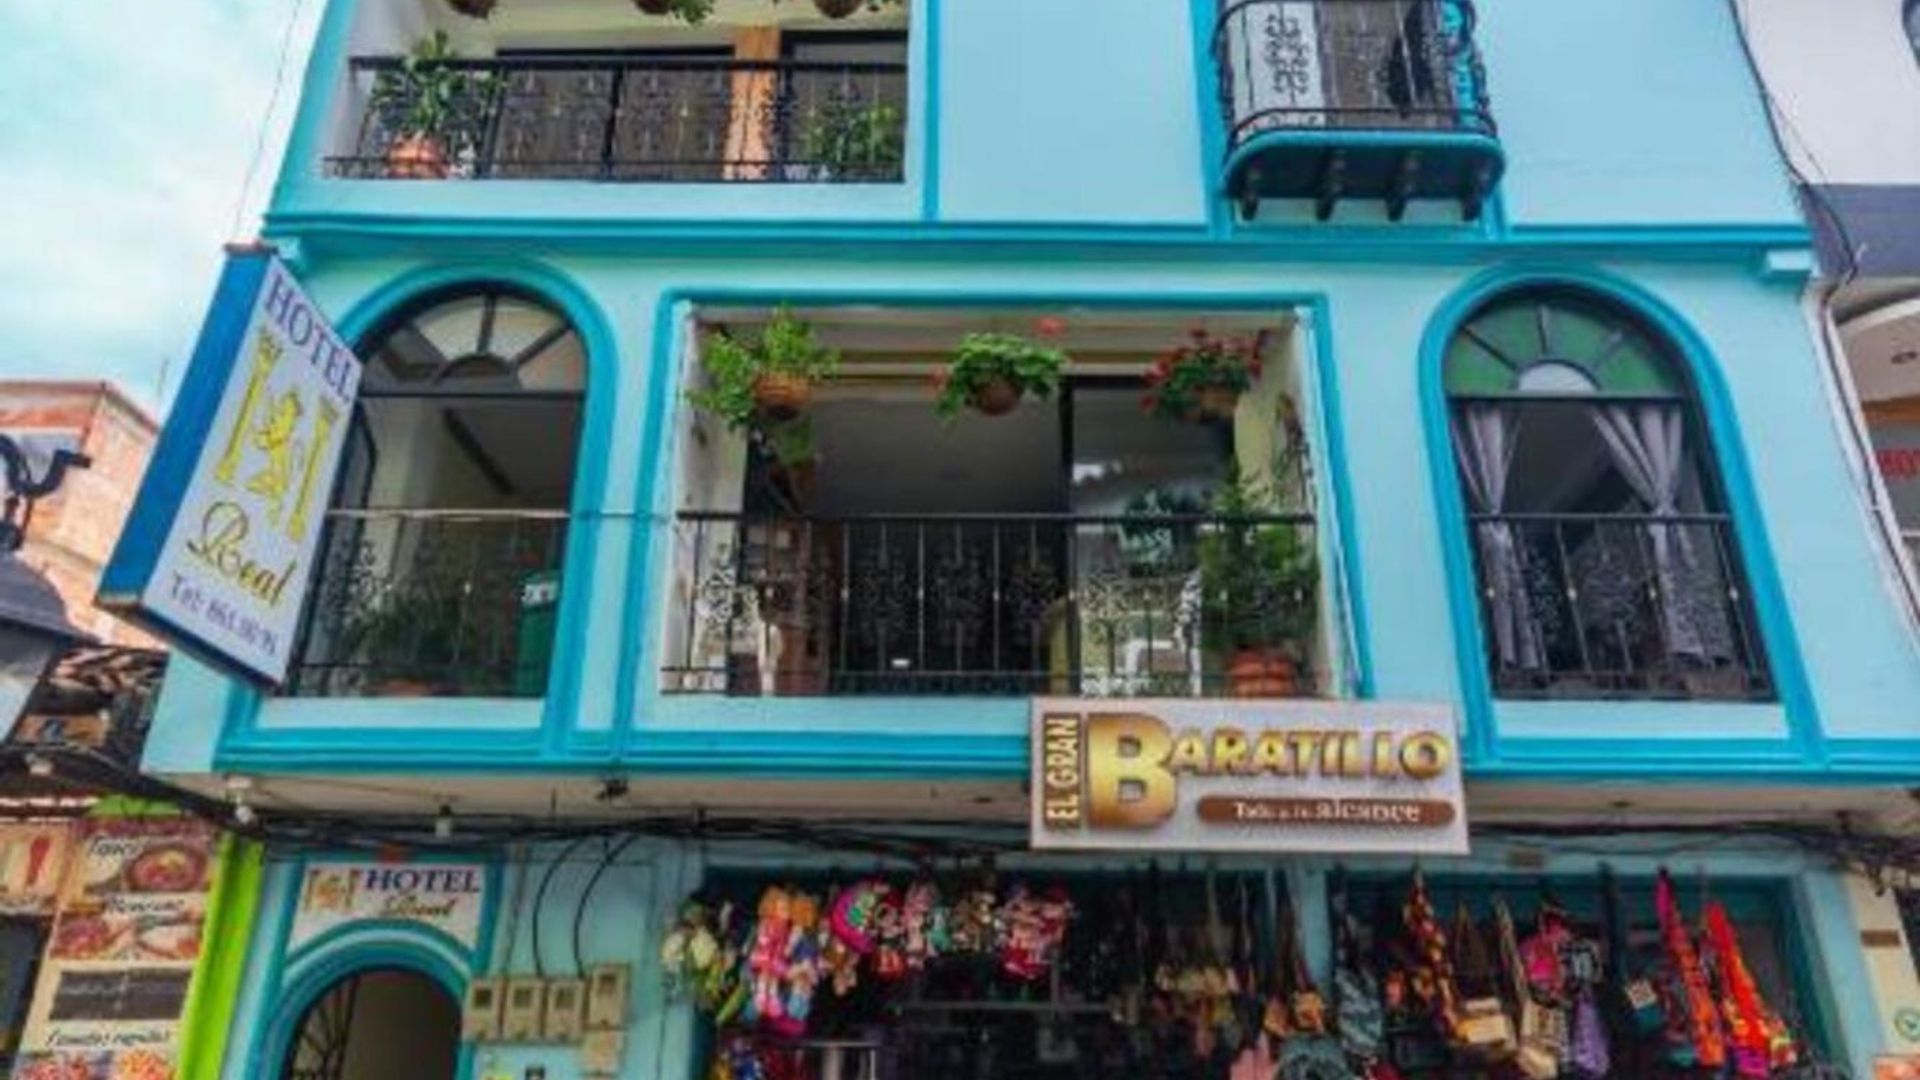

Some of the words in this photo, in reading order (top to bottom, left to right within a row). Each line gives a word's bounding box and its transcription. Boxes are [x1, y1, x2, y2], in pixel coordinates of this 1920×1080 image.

[264, 271, 353, 403] HOTEL
[187, 501, 297, 606] Real
[1045, 717, 1079, 788] GRAN
[1086, 711, 1451, 831] BARATILLO
[1045, 794, 1079, 819] EL
[1315, 800, 1421, 822] alcance
[366, 868, 481, 893] HOTEL
